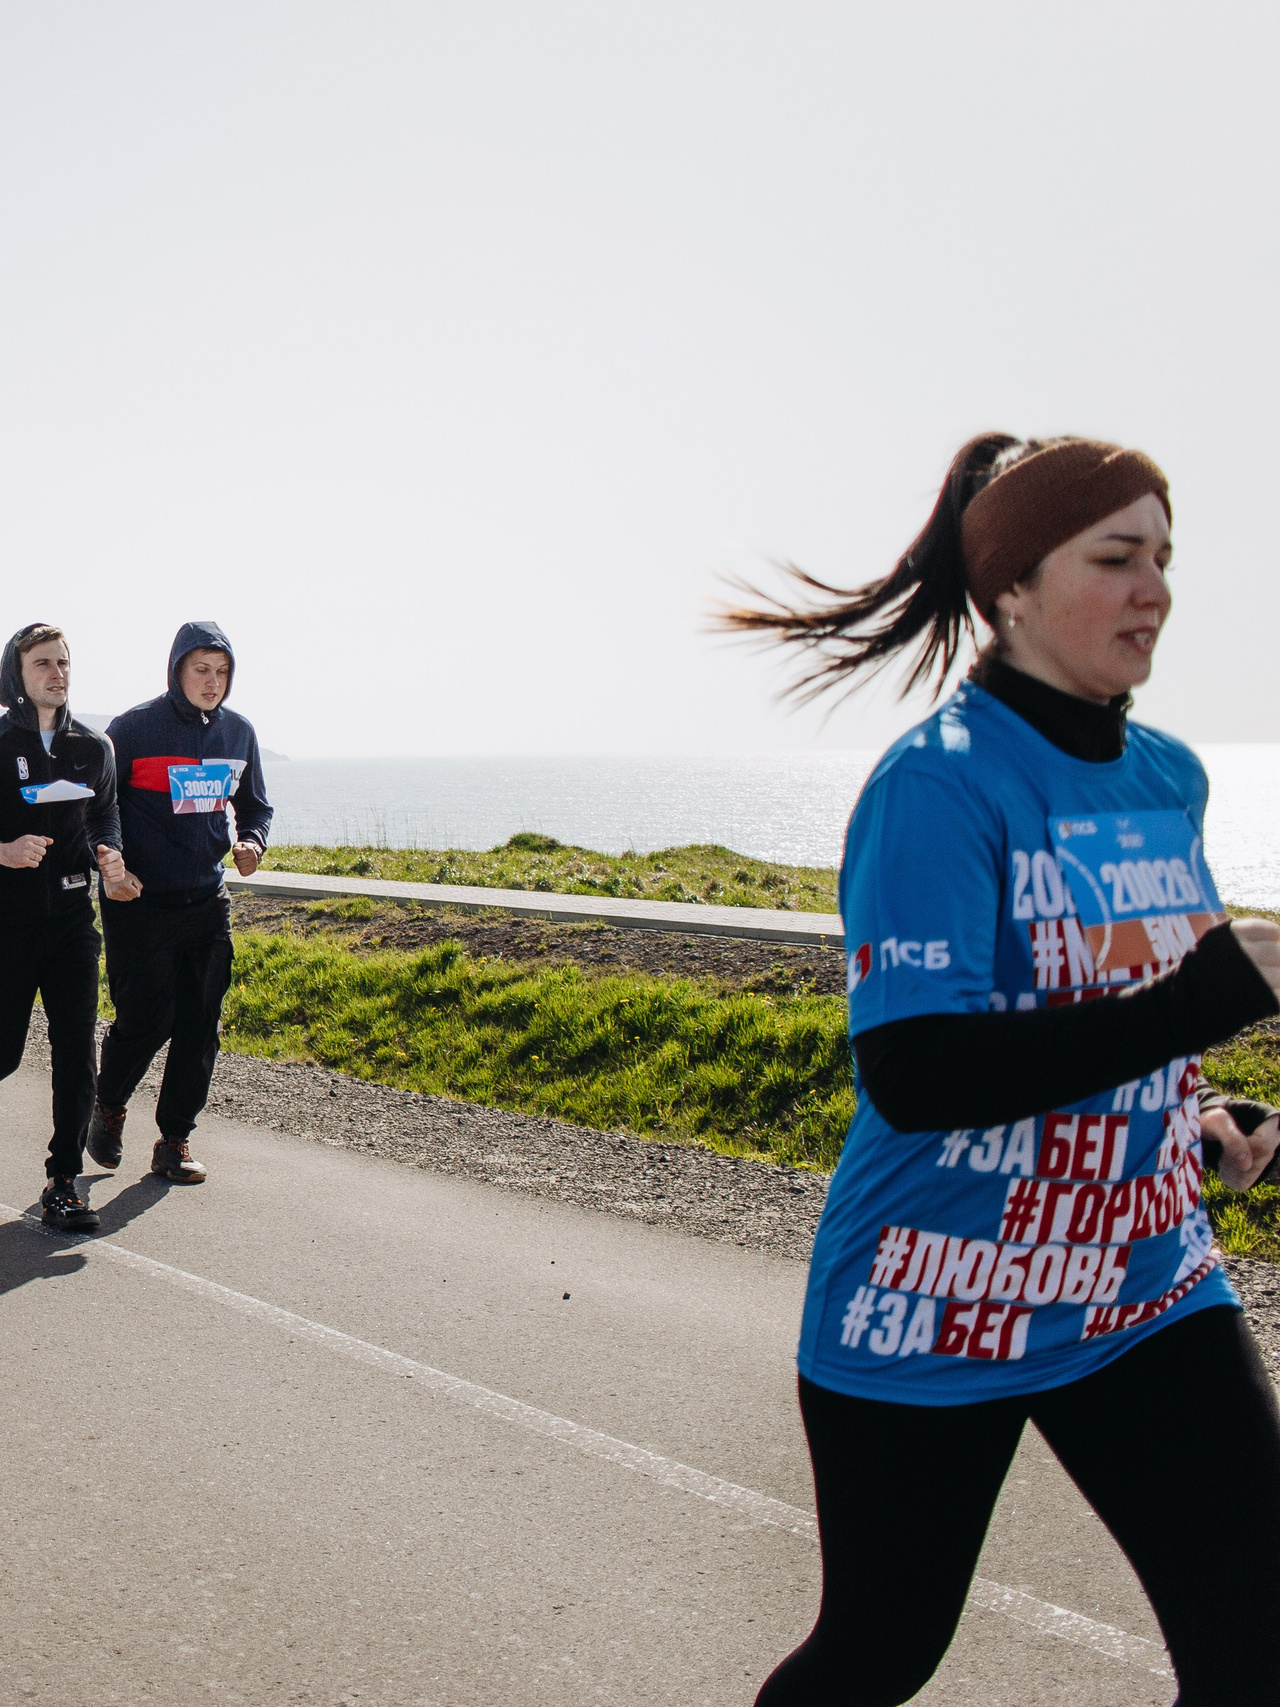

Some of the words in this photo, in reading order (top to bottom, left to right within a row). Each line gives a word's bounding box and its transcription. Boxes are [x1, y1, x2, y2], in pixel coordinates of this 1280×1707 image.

[184, 780, 222, 797] 30020
[1100, 857, 1199, 913] 20026
[880, 937, 951, 971] ПСБ
[936, 1112, 1130, 1182] #ЗАБЕГ
[869, 1225, 1132, 1305] #ЛЮБОВЬ
[841, 1286, 1034, 1361] #ЗАБЕГ
